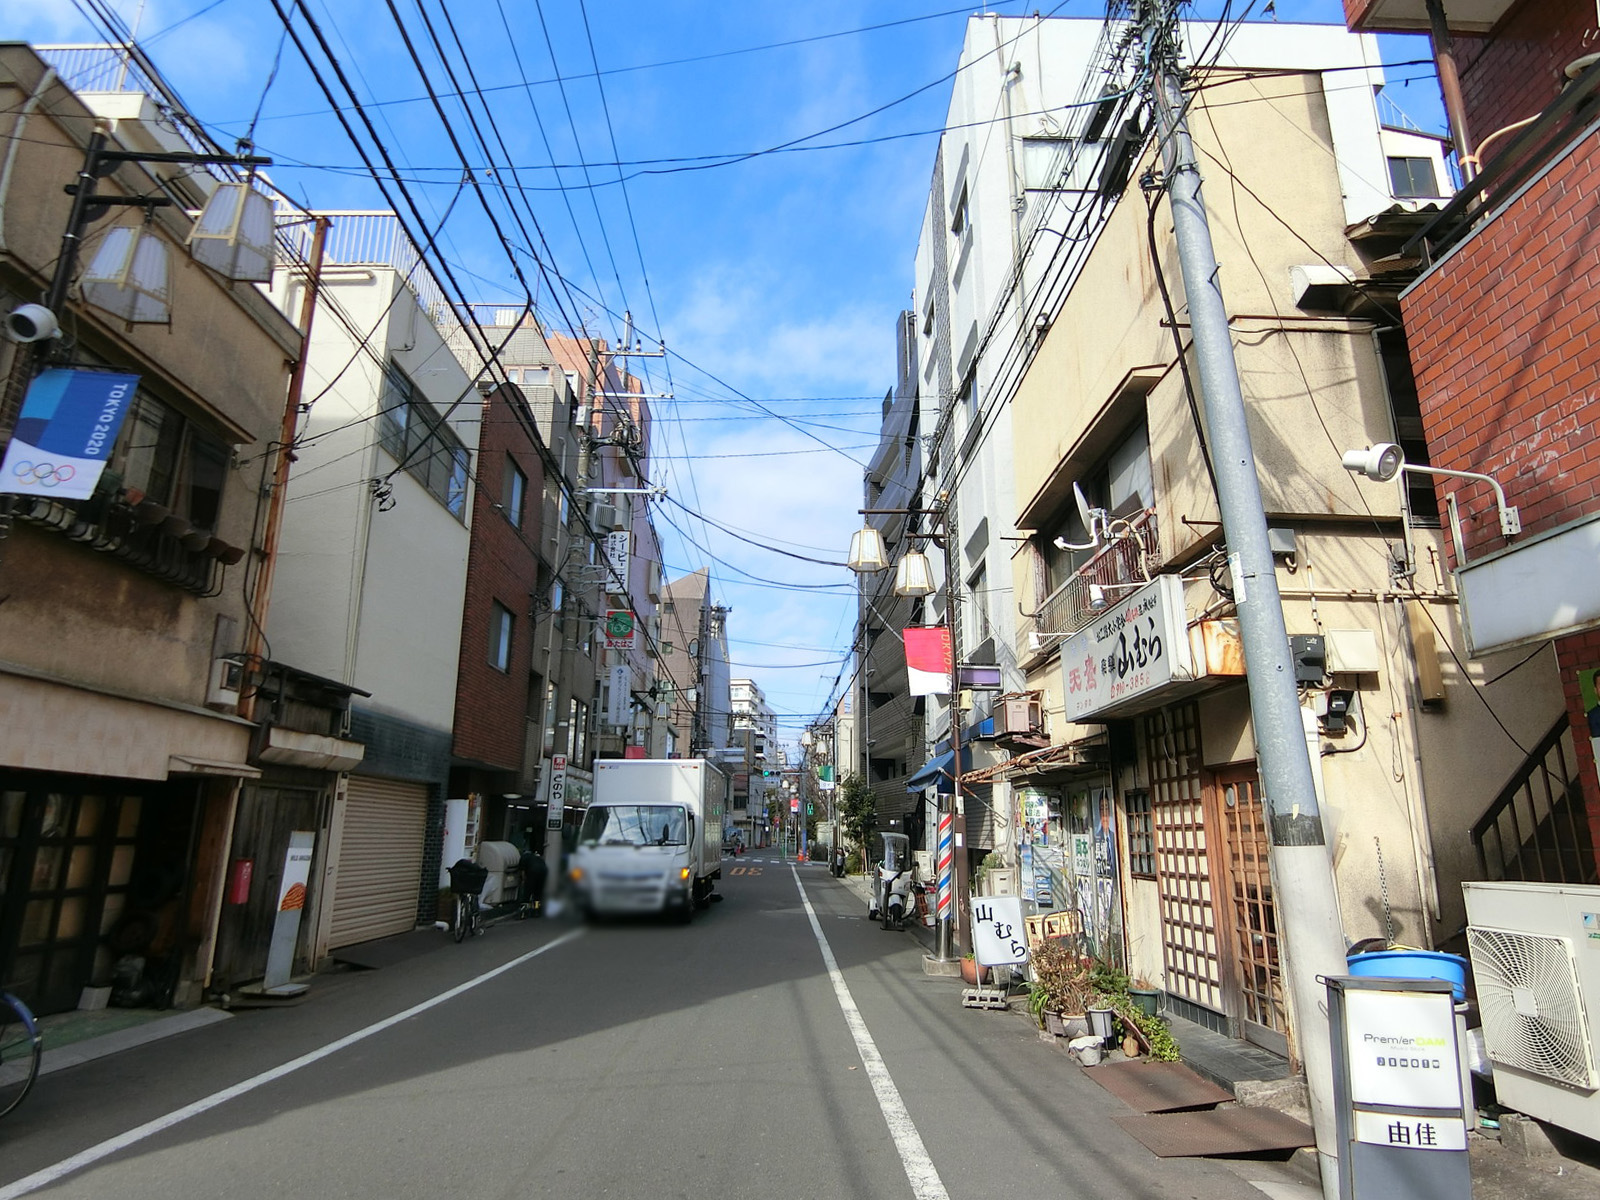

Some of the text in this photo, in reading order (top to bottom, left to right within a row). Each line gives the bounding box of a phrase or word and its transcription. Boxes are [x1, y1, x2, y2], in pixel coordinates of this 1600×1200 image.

[84, 383, 129, 455] TOKYO 2020
[940, 627, 952, 665] TOKYO
[1117, 616, 1162, 679] 山むら
[975, 904, 1026, 958] 山むら
[1387, 1121, 1438, 1146] 由佳
